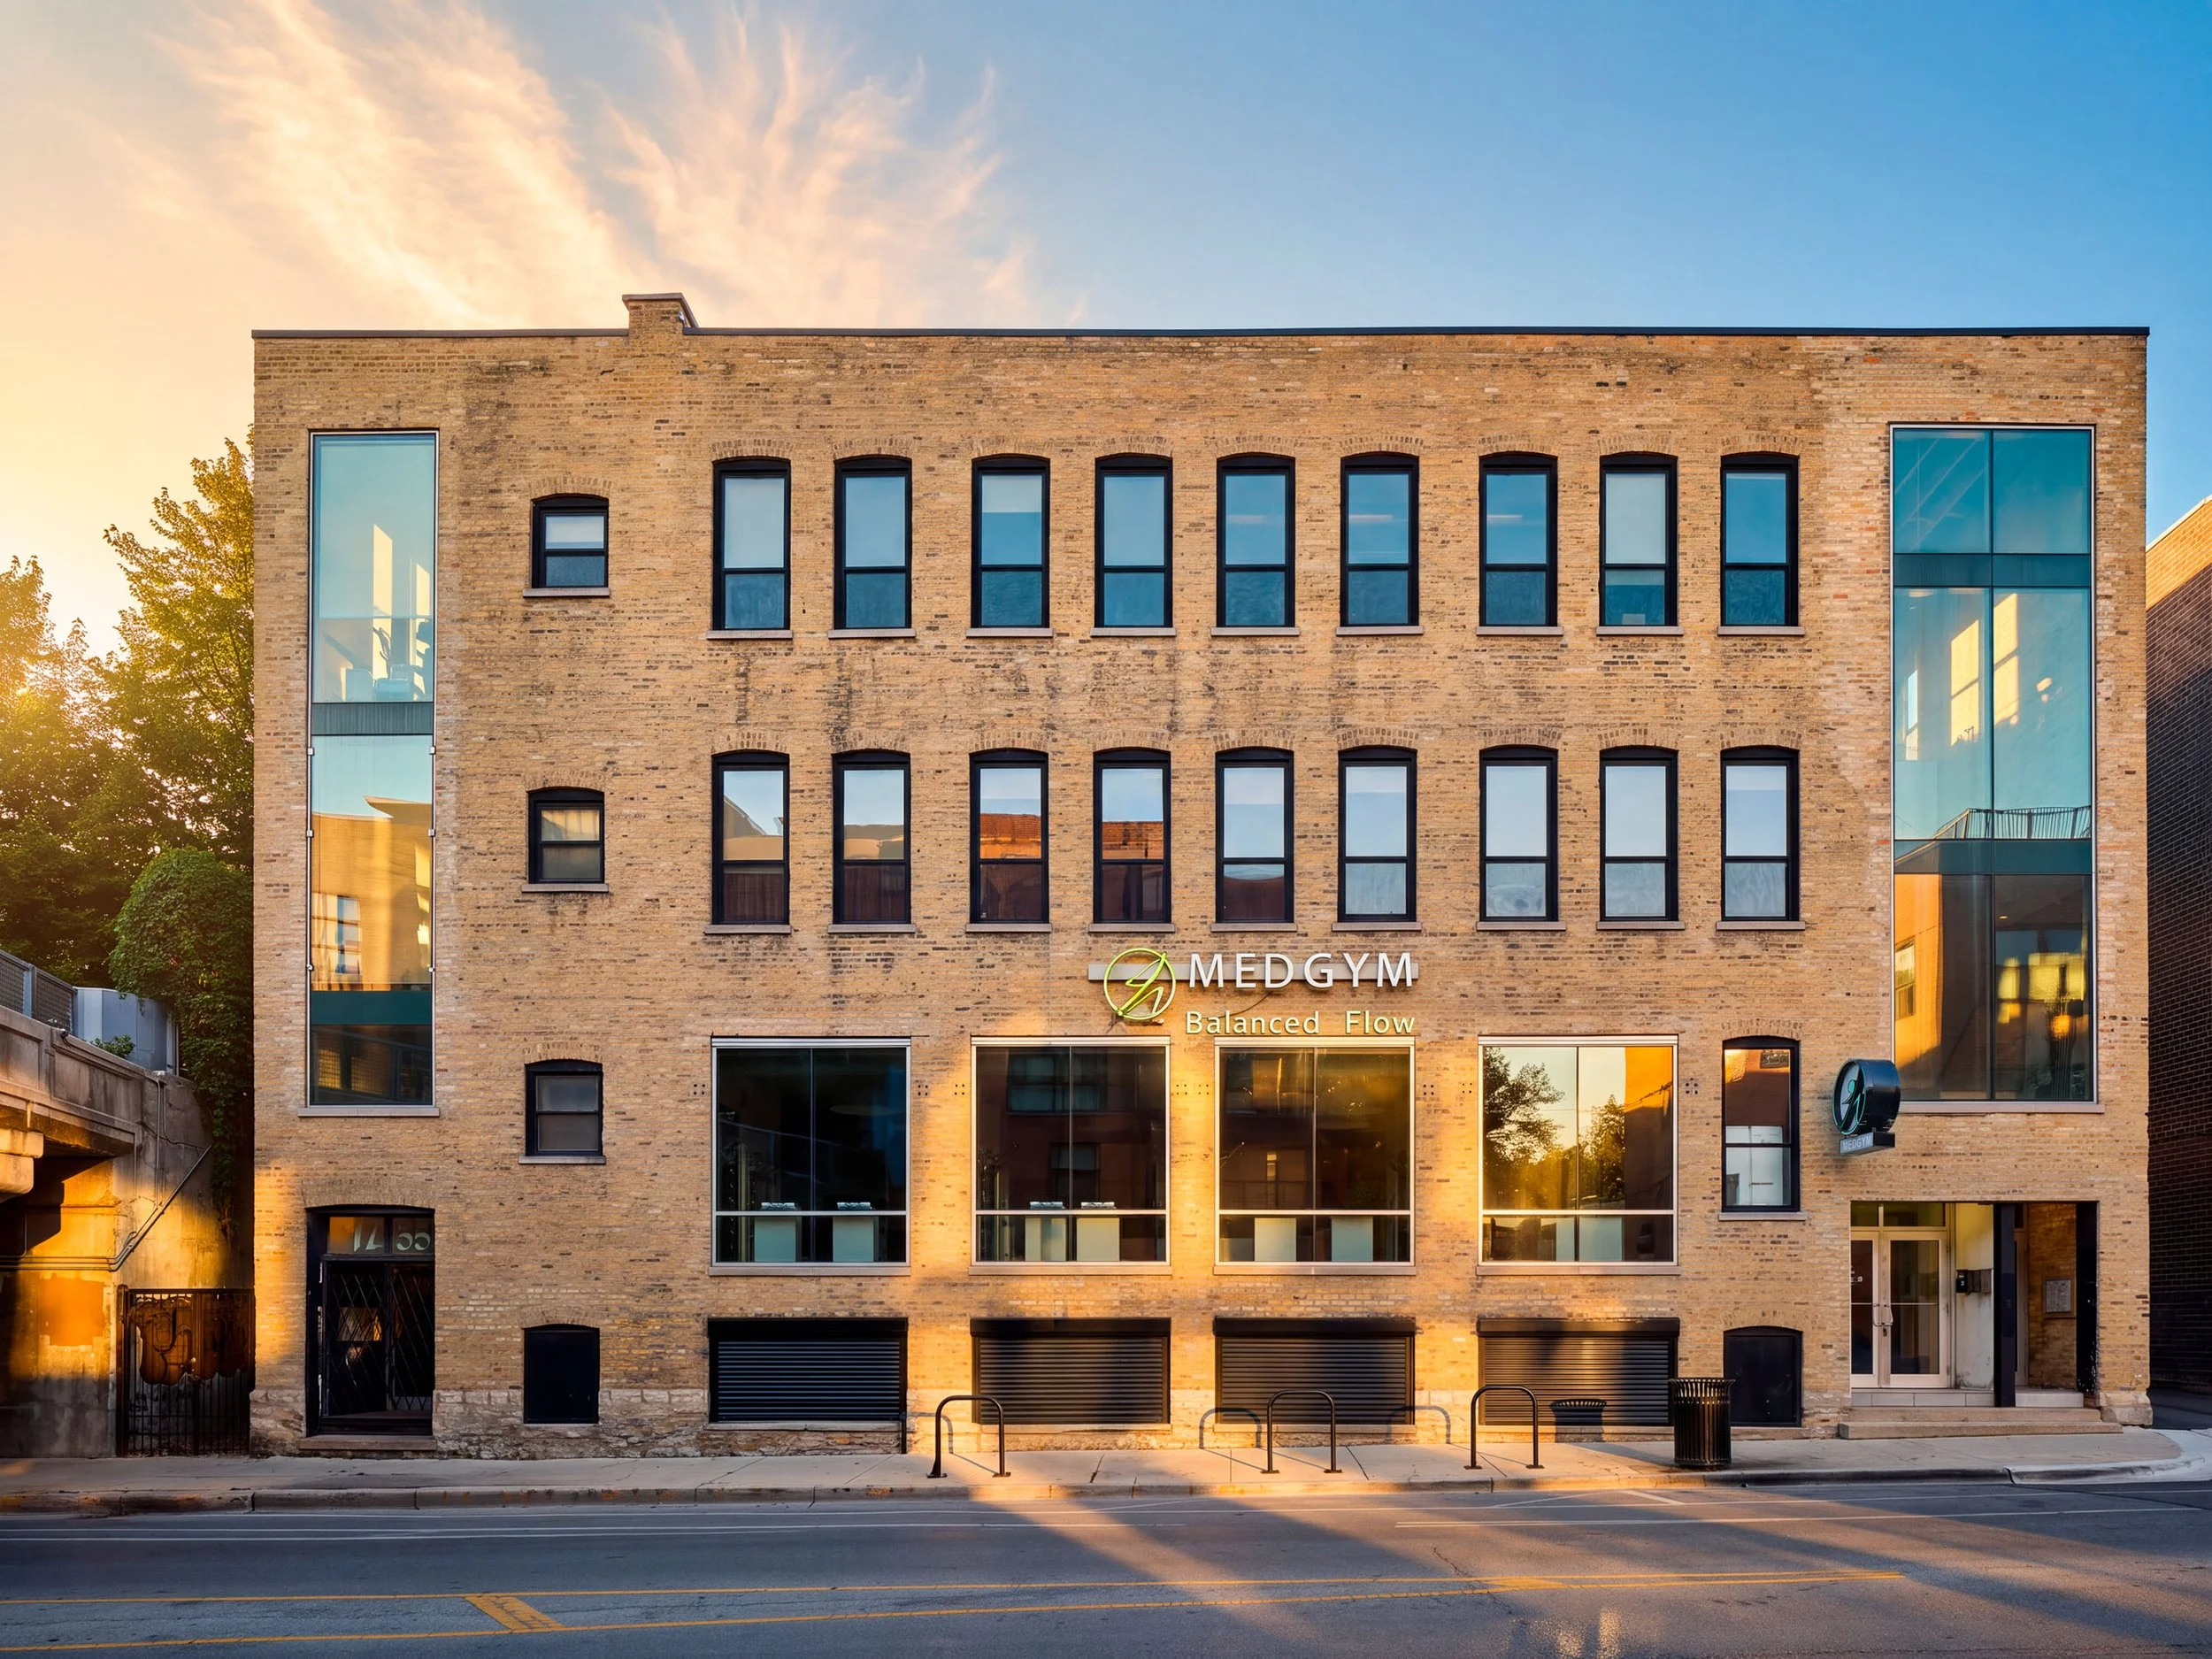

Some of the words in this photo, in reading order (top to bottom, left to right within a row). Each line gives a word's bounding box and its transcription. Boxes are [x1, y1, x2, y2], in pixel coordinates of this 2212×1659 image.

[1189, 953, 1413, 988] MEDGYM
[1187, 1010, 1319, 1034] Balanced
[1346, 1010, 1416, 1033] Flow
[1843, 1136, 1871, 1148] MEDGYM
